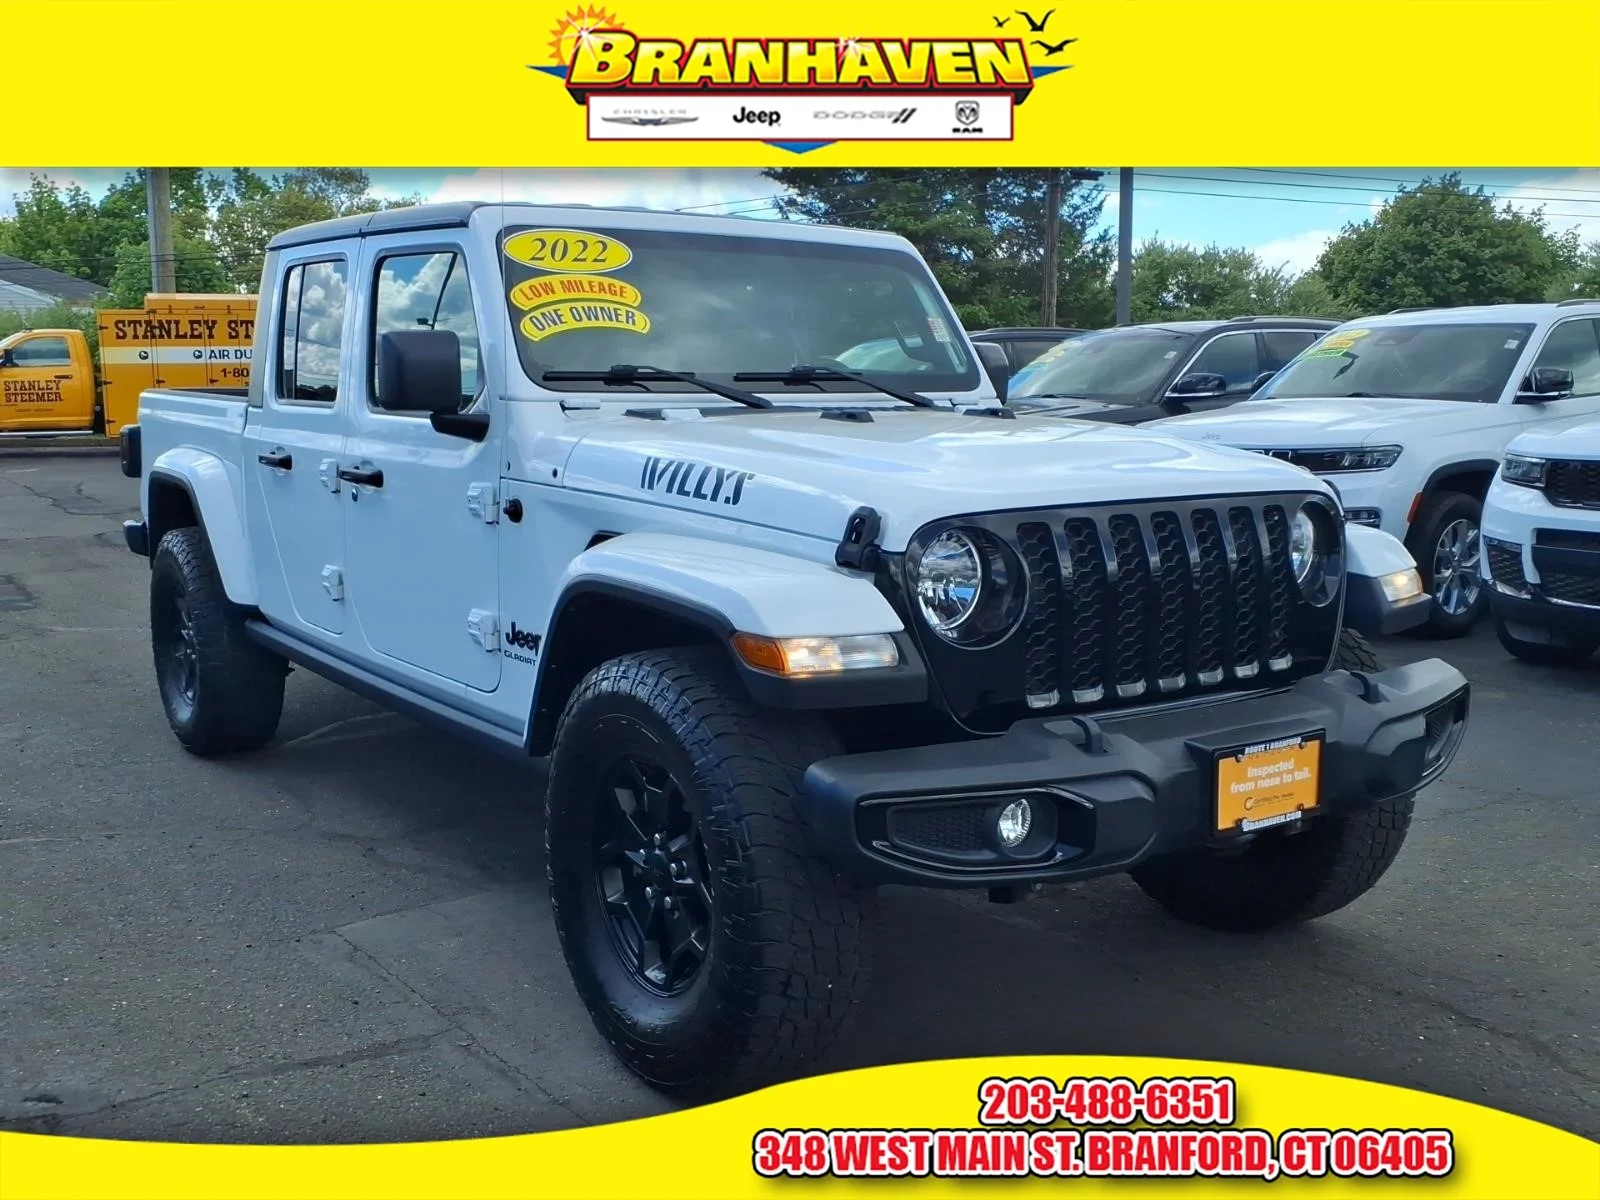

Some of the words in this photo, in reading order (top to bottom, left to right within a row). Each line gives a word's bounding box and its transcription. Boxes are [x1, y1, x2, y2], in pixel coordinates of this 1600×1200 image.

[528, 238, 609, 263] 2022
[519, 280, 556, 301] LOW
[558, 279, 628, 299] MILEAGE
[529, 308, 568, 331] ONE
[568, 306, 636, 326] OWNER
[114, 319, 218, 340] STANLEY
[208, 349, 230, 360] AIR
[3, 380, 62, 392] STANLEY
[4, 392, 63, 403] STEEMER
[640, 456, 756, 506] WILLYS
[1248, 758, 1294, 778] Inspected
[1230, 782, 1255, 793] from
[1257, 777, 1280, 788] nose
[1283, 773, 1292, 783] to
